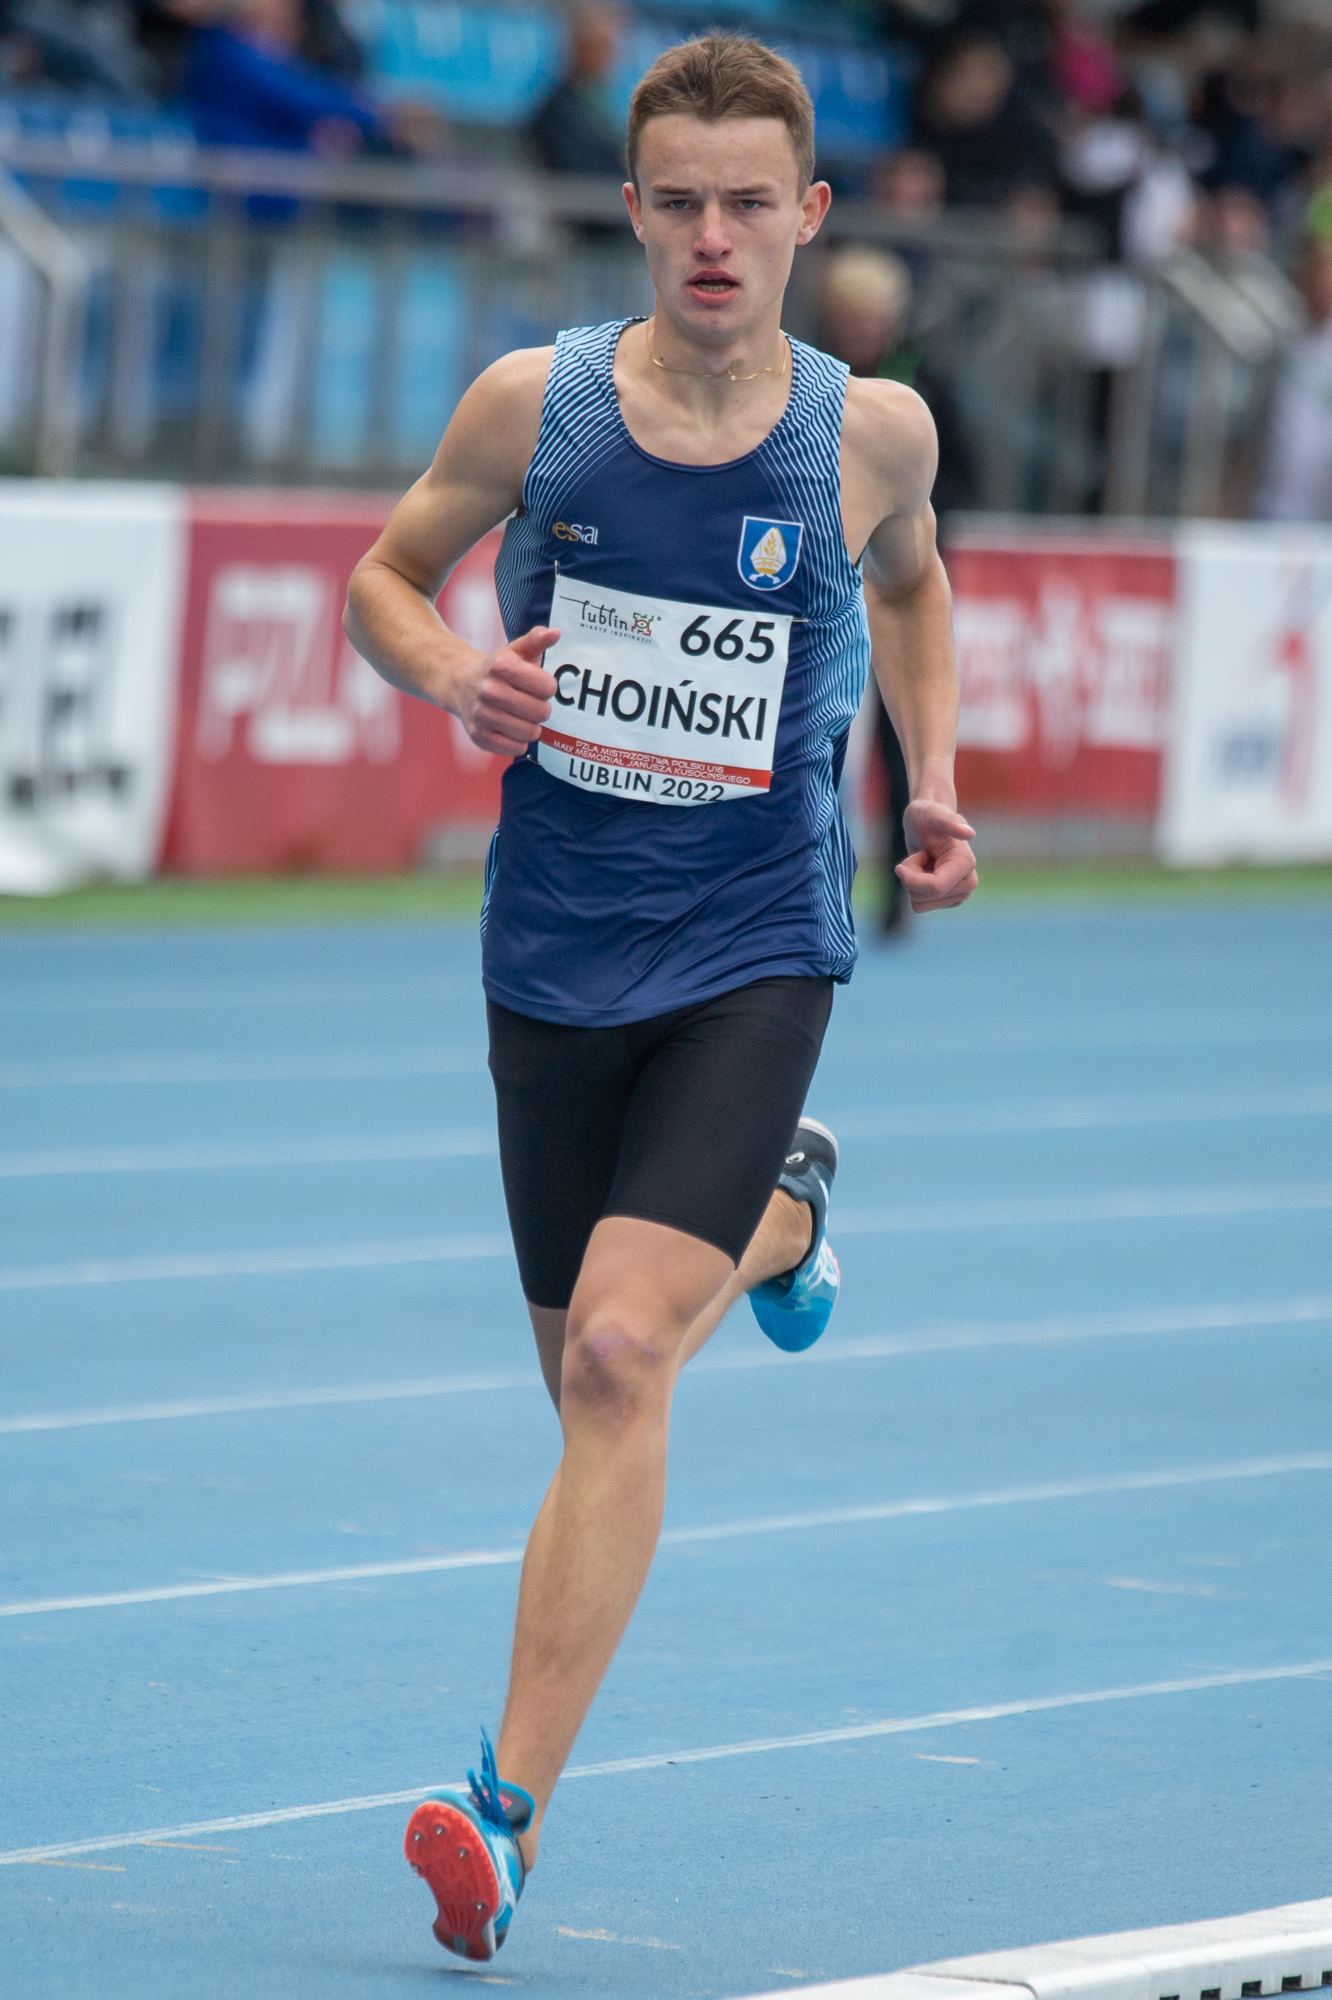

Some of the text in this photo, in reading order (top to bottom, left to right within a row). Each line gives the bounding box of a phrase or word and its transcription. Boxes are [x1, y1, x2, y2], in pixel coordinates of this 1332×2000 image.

[580, 623, 608, 634] MIASTO
[680, 615, 774, 664] 665
[555, 664, 768, 741] CHOIŃSKI
[553, 740, 574, 753] MAŁY
[575, 748, 625, 766] MEMORIAŁ
[626, 760, 672, 774] JANUSZA
[576, 740, 724, 774] PZLA MISTRZOSTWA POLSKI U16
[569, 758, 725, 803] LUBLIN 2022
